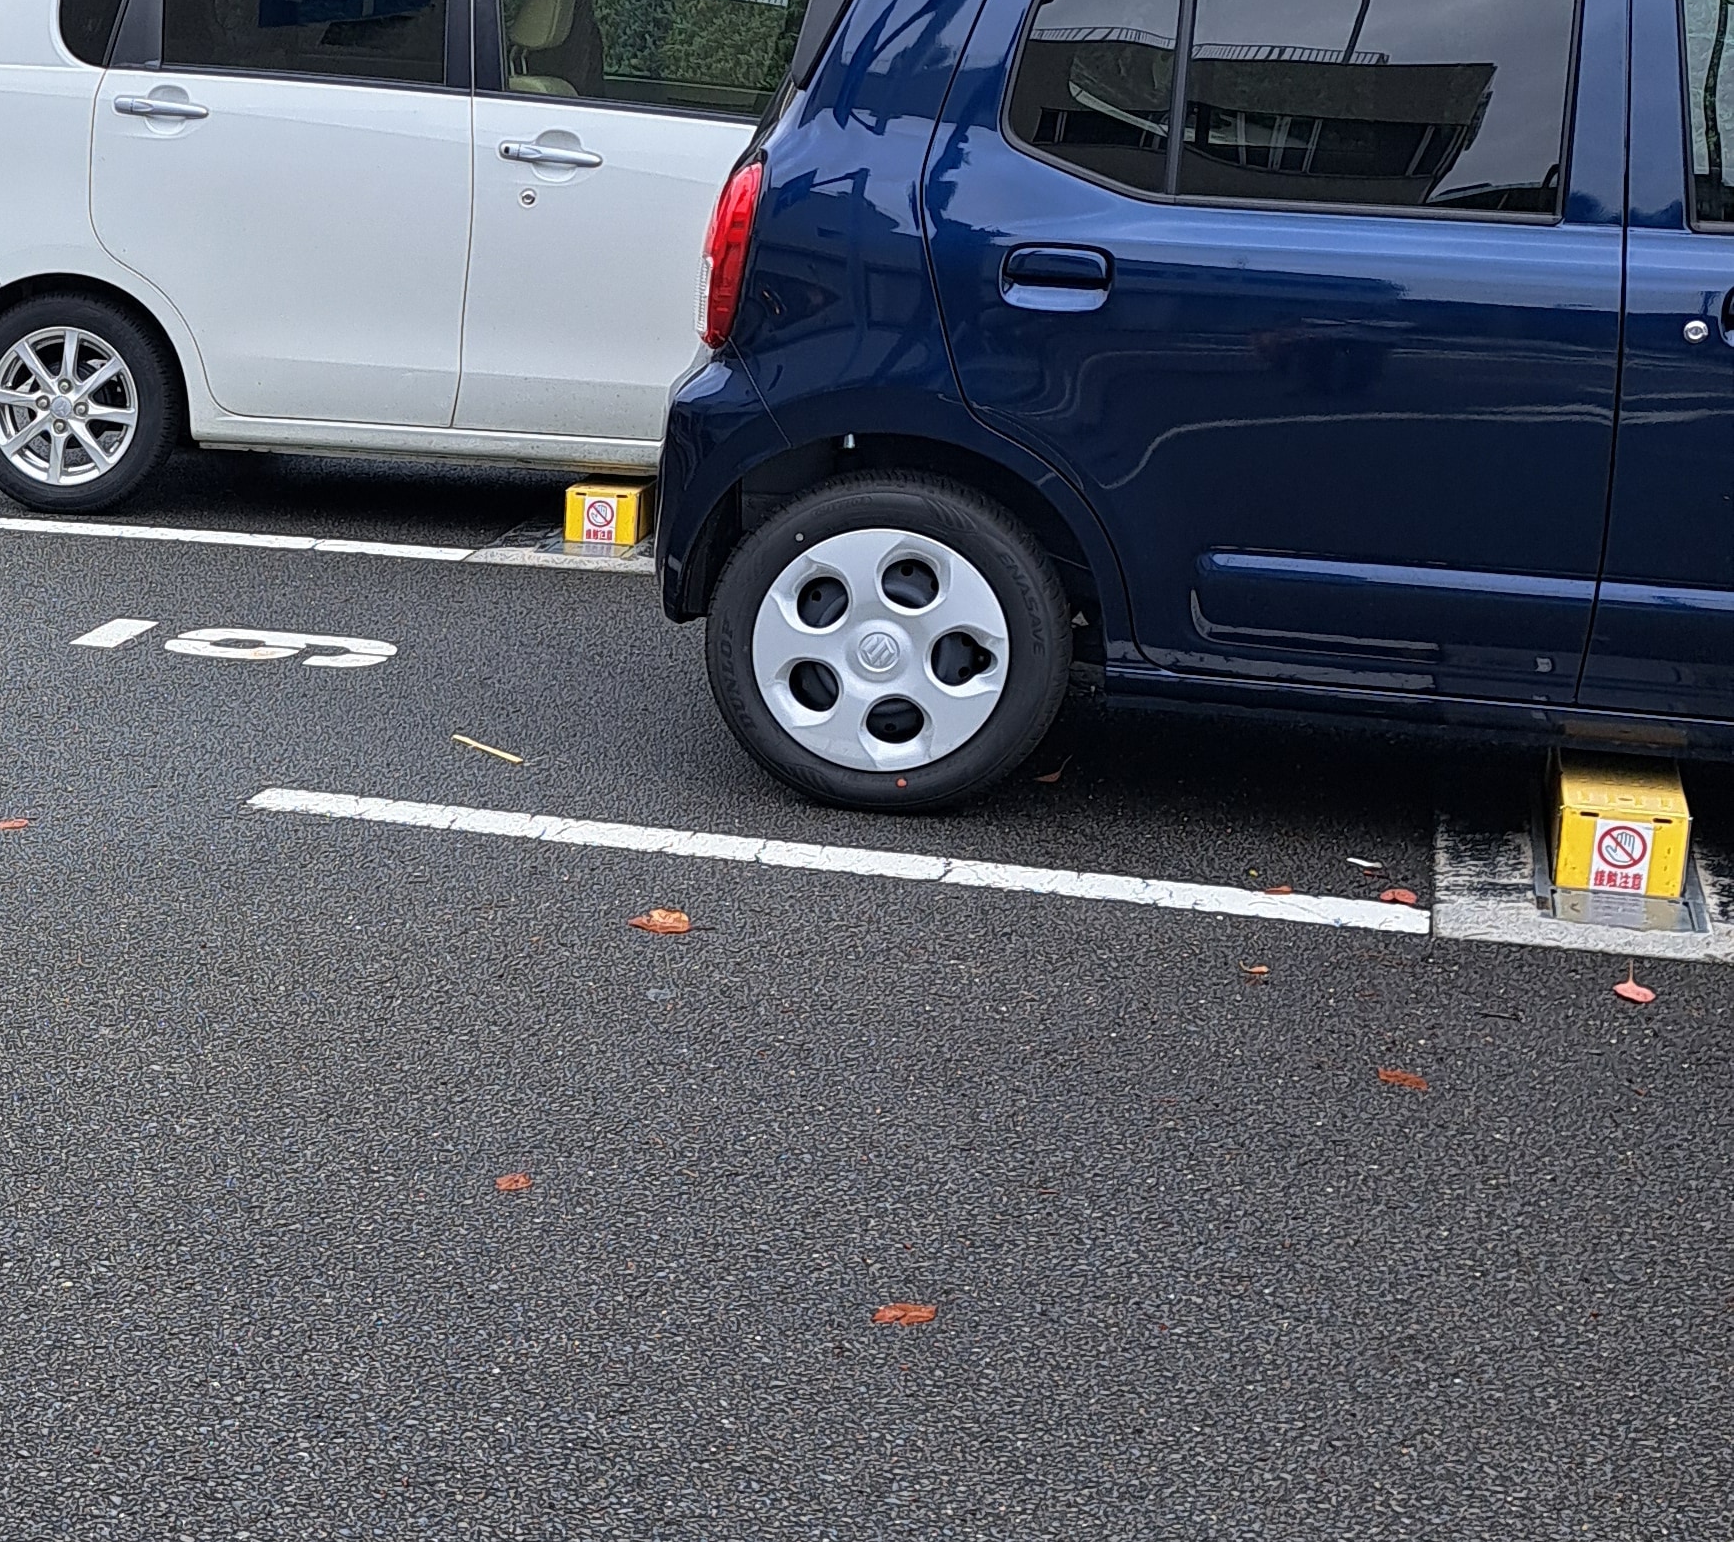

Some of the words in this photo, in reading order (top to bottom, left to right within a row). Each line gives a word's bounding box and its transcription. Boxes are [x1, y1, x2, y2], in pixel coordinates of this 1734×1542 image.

[995, 549, 1044, 656] ENASAVE
[718, 617, 757, 735] DUNLOP
[1593, 870, 1643, 891] 接触注意
